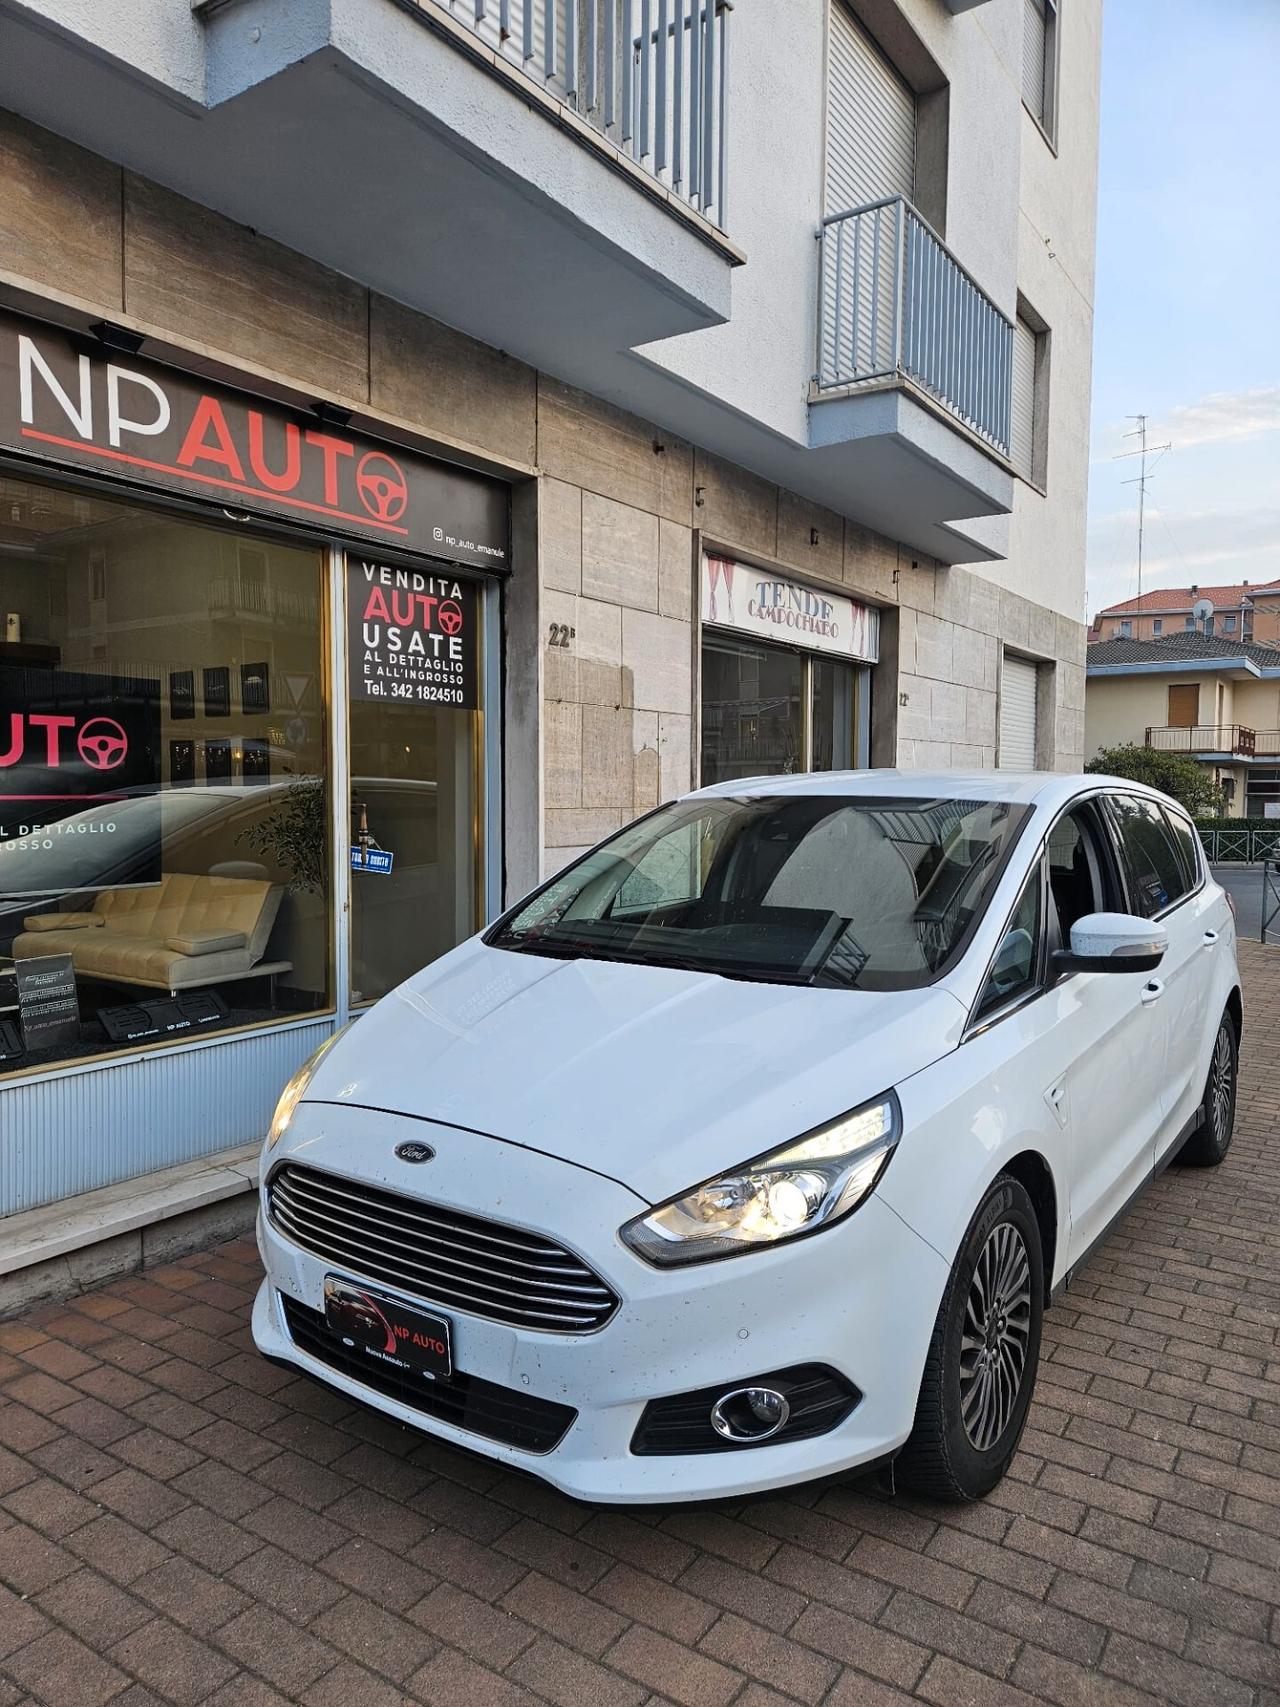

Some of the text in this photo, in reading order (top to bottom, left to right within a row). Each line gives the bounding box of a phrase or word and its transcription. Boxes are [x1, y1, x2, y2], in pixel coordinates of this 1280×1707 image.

[18, 335, 171, 447] NP
[362, 562, 463, 600] VENDITA
[747, 599, 839, 639] CAMPOCHIARO
[363, 622, 463, 660] USATE
[364, 650, 464, 673] AL DETTAGLIO
[364, 664, 464, 685] E ALL'INGROSSO
[364, 680, 464, 703] Tel. 342 1824510
[19, 822, 117, 836] DETTAGLIO
[0, 839, 53, 851] OSSO
[402, 1144, 428, 1160] Ford
[393, 1324, 445, 1354] NP AUTO
